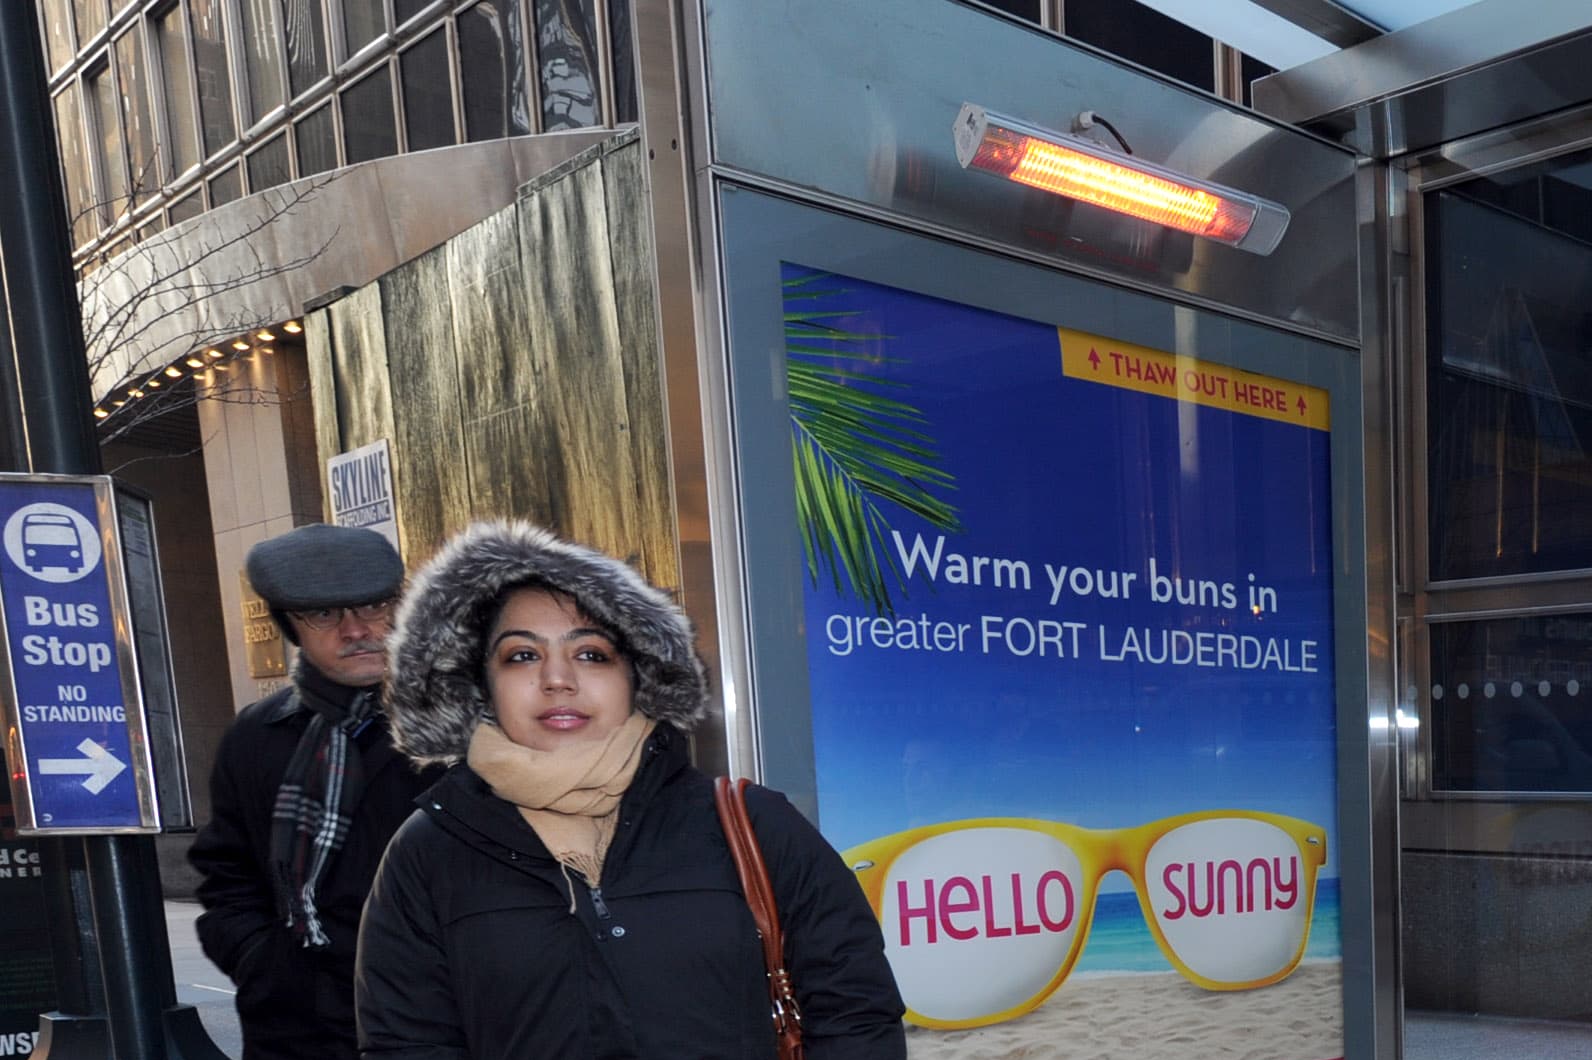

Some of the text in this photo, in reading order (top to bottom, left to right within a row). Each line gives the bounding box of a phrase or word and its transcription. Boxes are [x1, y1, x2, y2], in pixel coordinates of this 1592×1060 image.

[1108, 351, 1288, 413] THAW OUT HERE
[332, 450, 388, 513] SKYLINE
[892, 530, 1278, 613] Warm your buns in
[24, 595, 100, 628] Bus
[22, 634, 112, 673] Stop
[825, 614, 1319, 673] greater FORT LAUDERDALE
[23, 705, 127, 723] STANDING
[57, 684, 88, 702] NO
